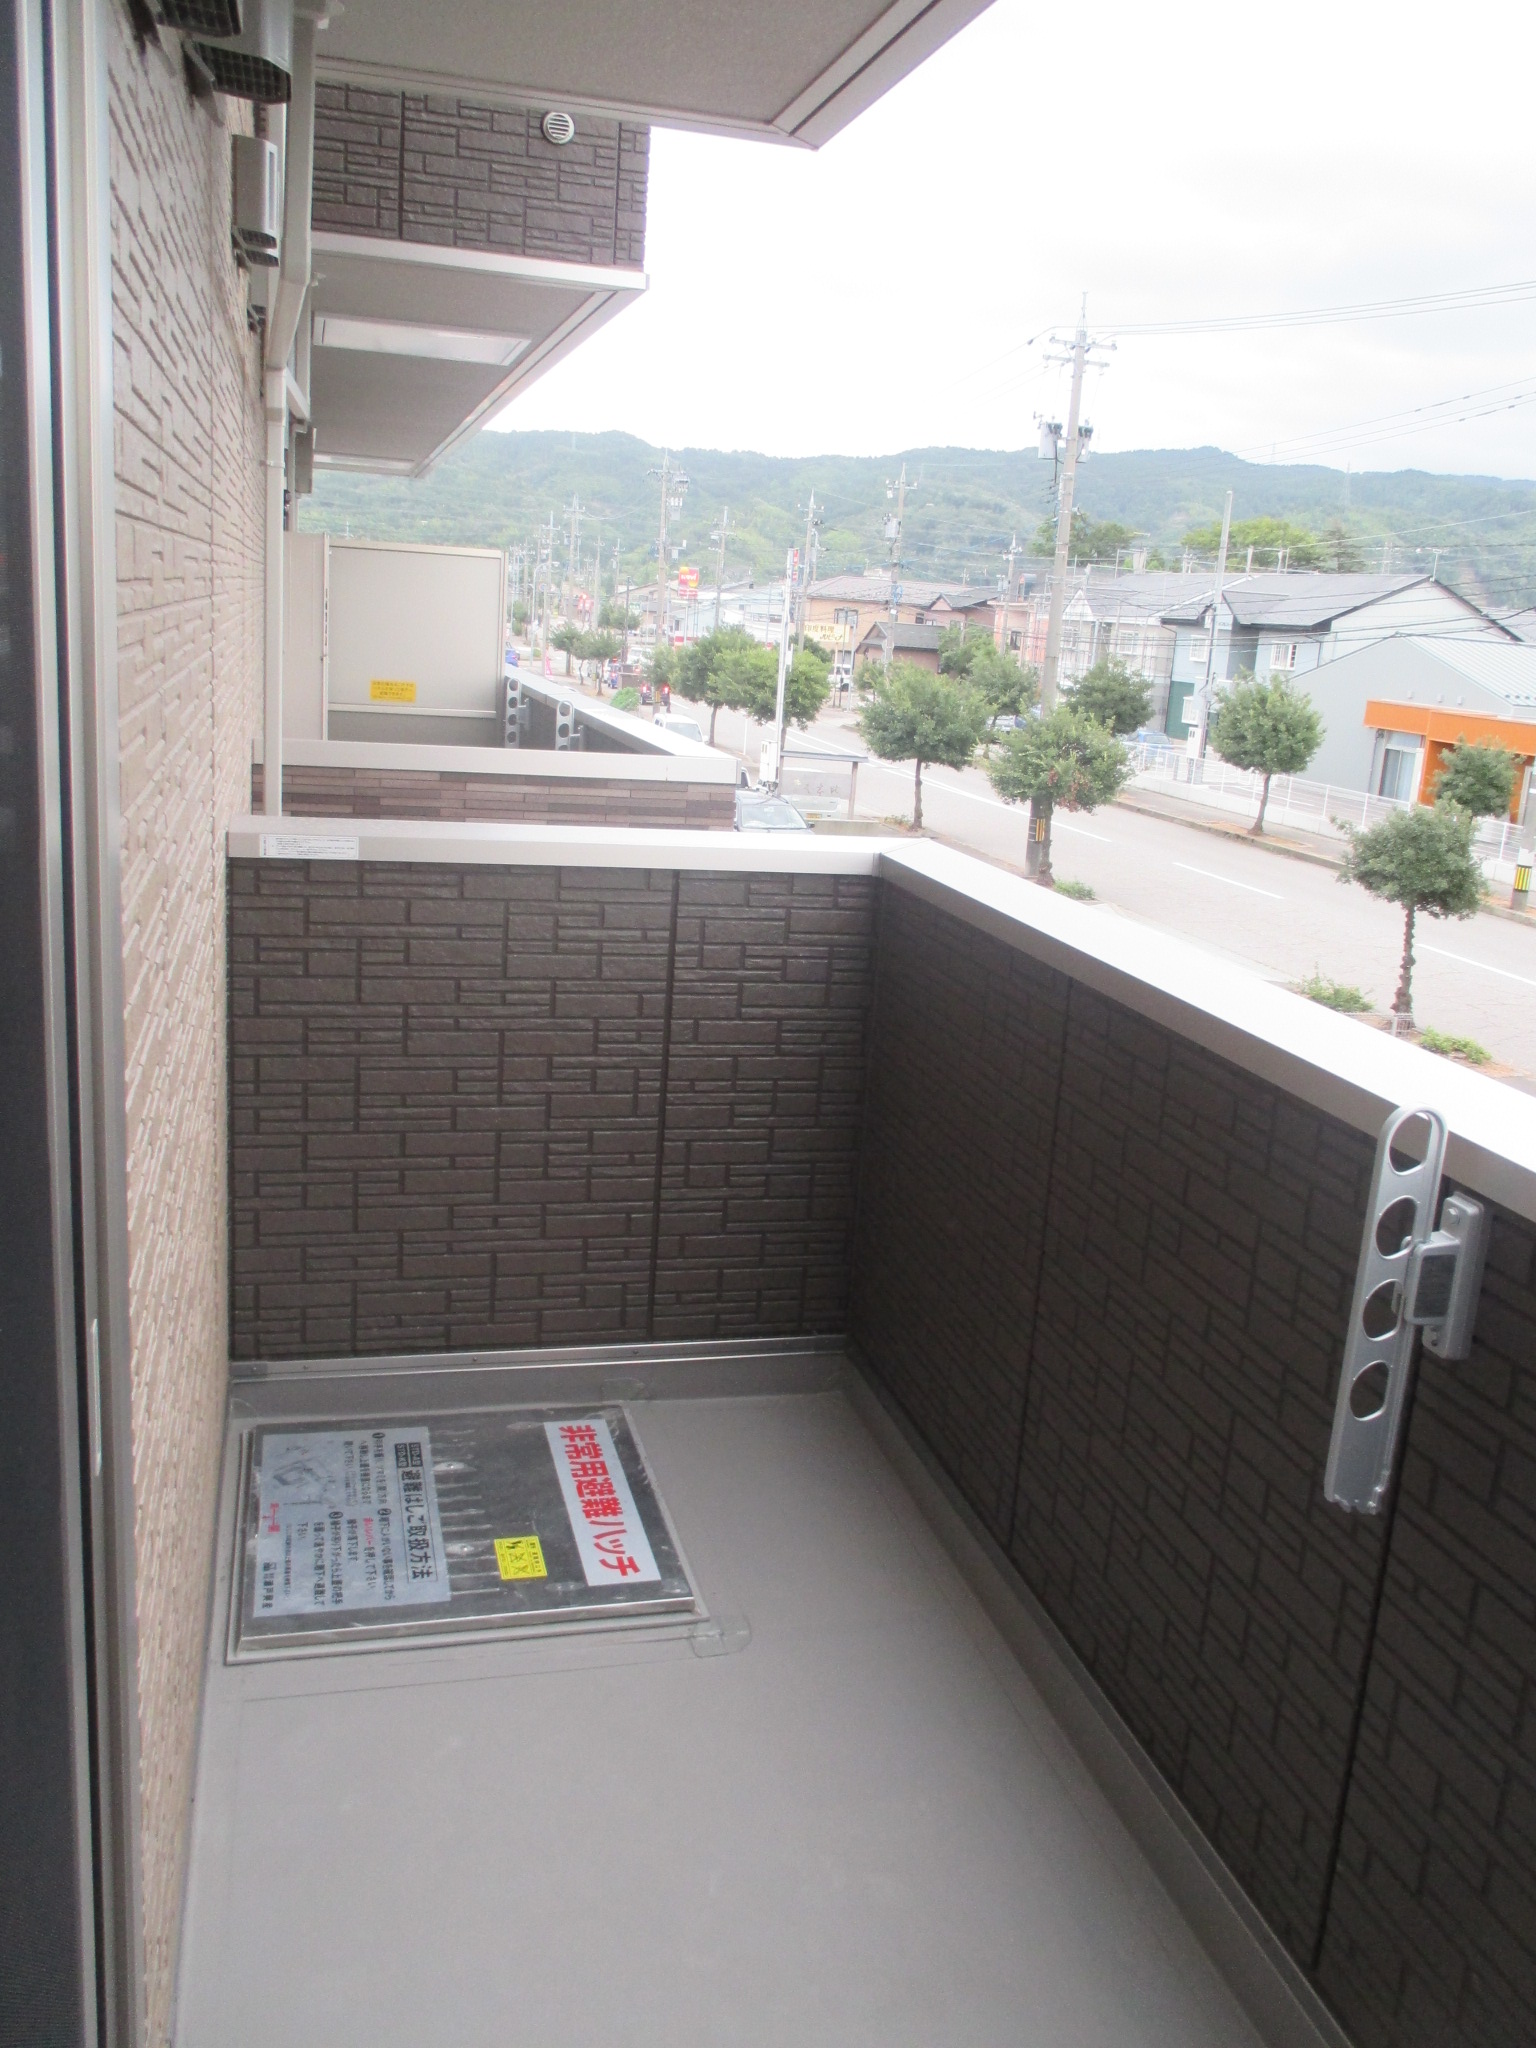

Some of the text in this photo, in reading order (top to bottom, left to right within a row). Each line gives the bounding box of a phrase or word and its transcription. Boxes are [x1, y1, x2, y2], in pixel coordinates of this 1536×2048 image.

[400, 1468, 433, 1579] 避難はしご取扱方法
[557, 1423, 644, 1578] 非常用避難ハッチ
